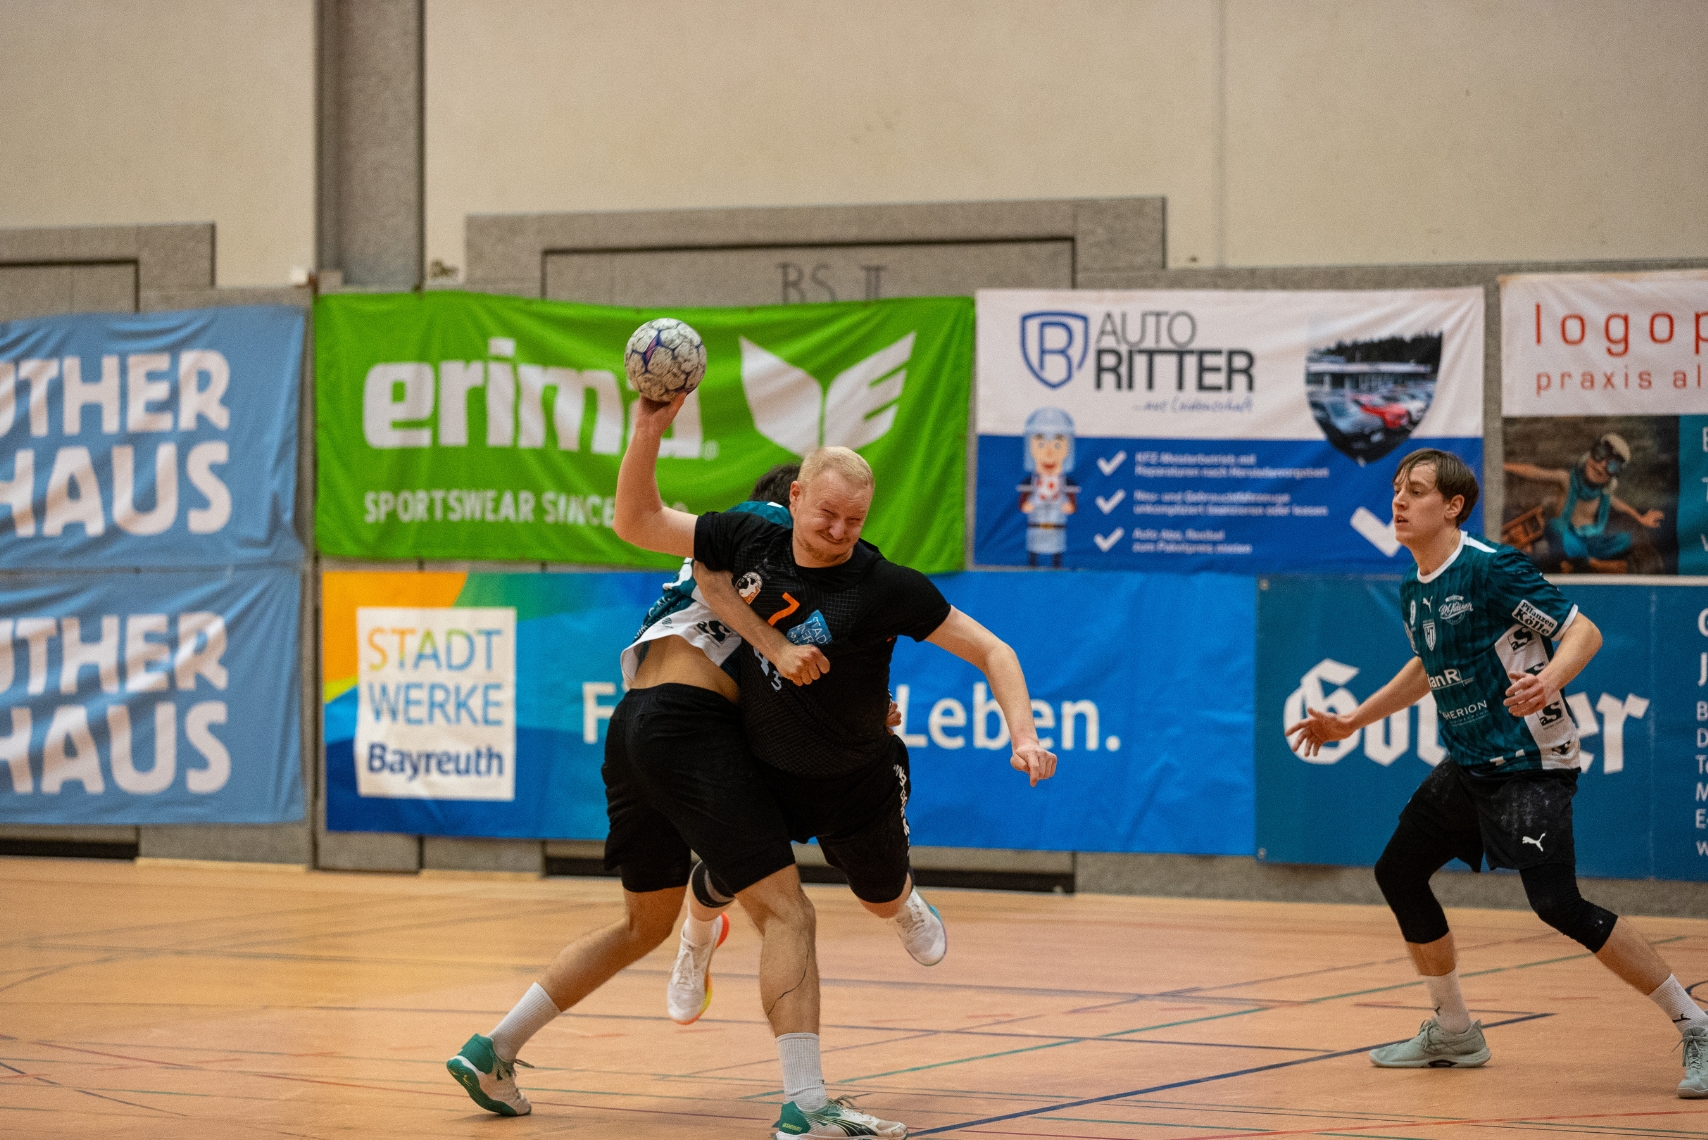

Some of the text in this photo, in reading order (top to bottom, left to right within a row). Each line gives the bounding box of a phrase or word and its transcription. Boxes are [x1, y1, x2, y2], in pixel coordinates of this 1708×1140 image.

[1096, 311, 1197, 348] AUTO
[1094, 348, 1255, 391] RITTER
[1536, 366, 1653, 398] praxis
[0, 441, 232, 537] HAUS
[364, 489, 614, 528] SPORTSWEAR SINCE
[767, 592, 800, 627] 7
[1514, 608, 1549, 634] Kölle
[1521, 602, 1554, 628] Pflanzen
[367, 626, 503, 672] STADT
[367, 682, 503, 726] WERKE
[893, 682, 1122, 751] Leben.
[0, 701, 231, 794] HAUS
[367, 742, 504, 781] Bayreuth
